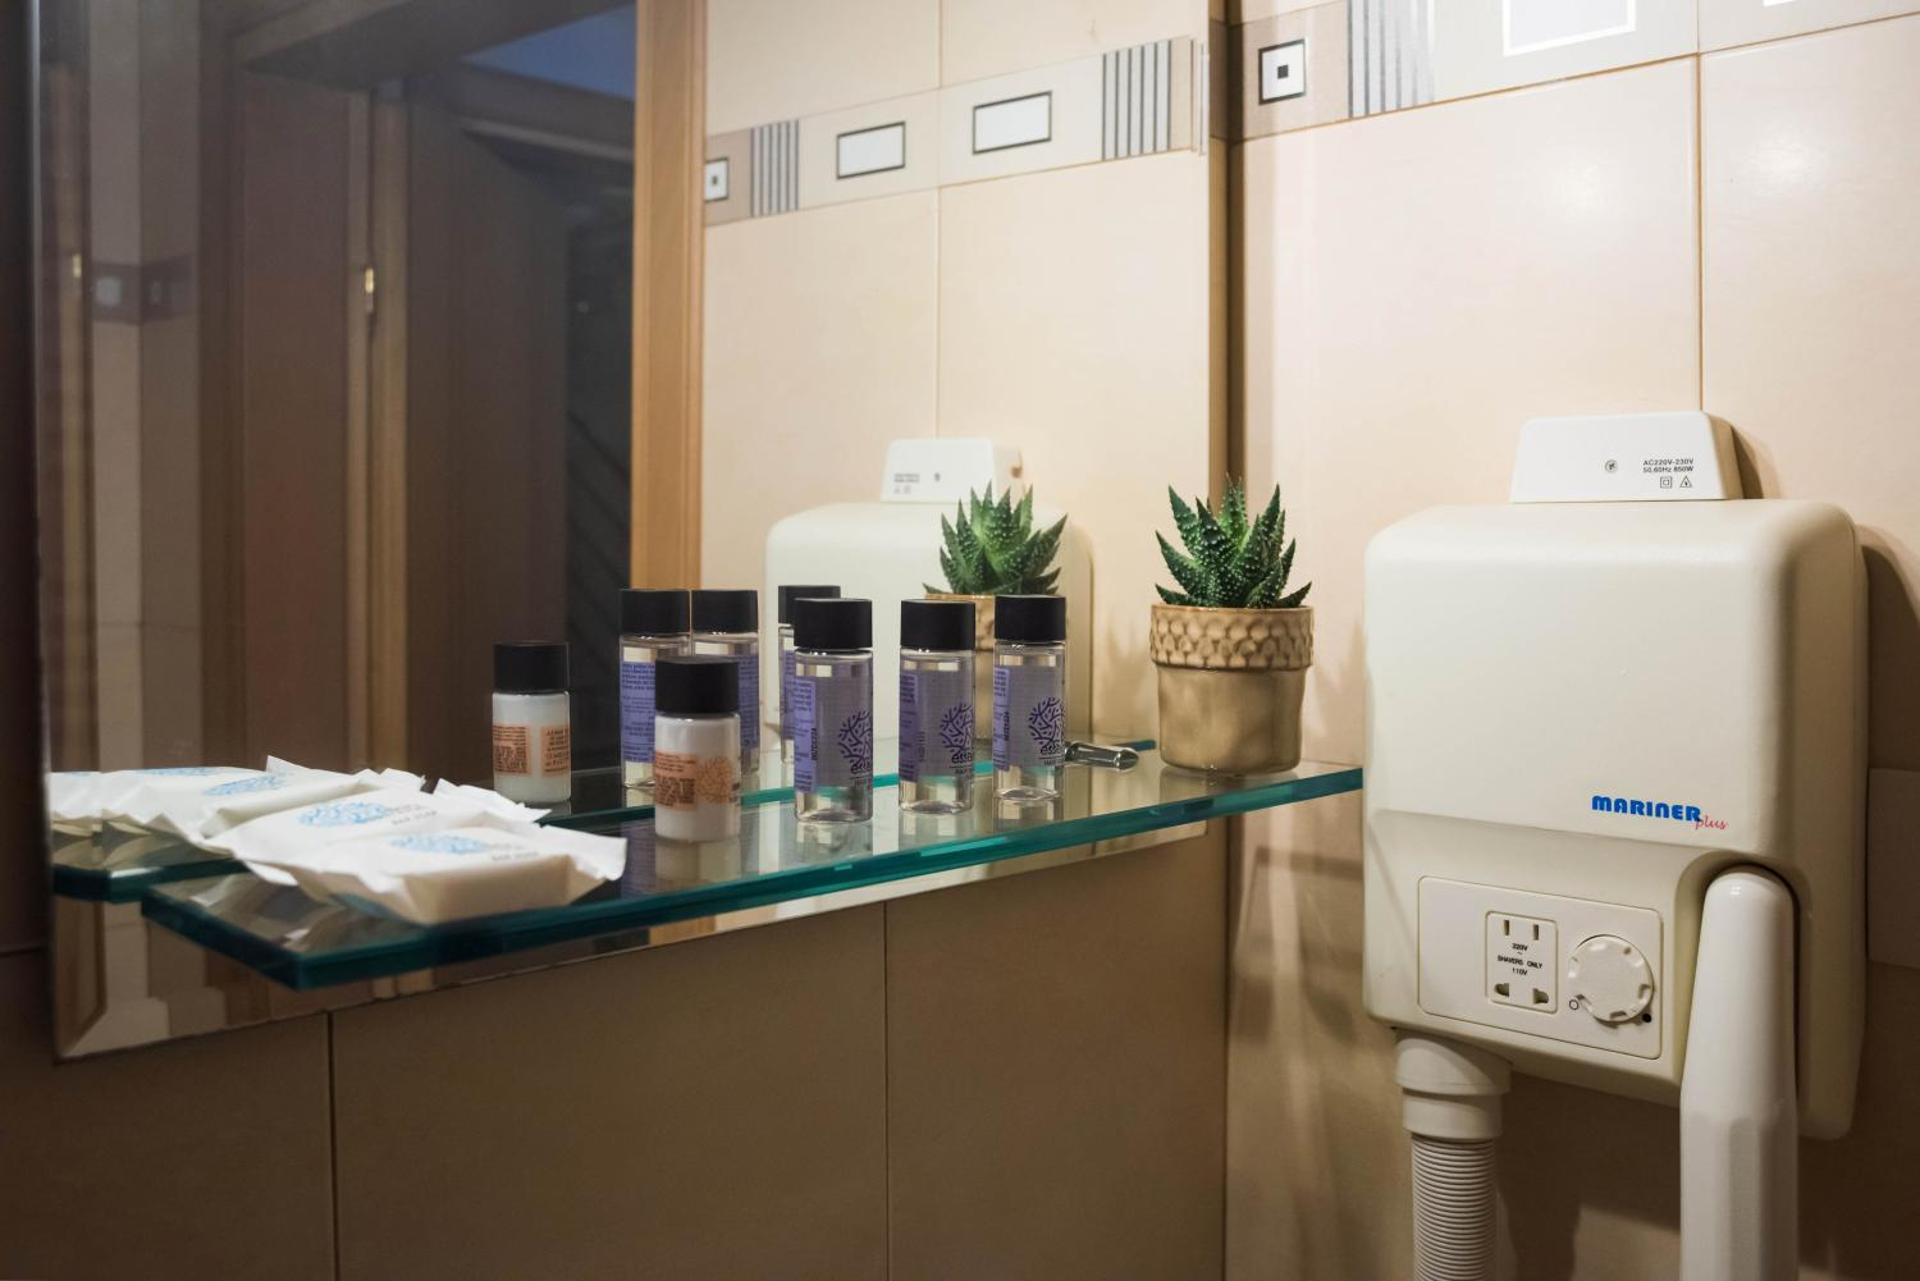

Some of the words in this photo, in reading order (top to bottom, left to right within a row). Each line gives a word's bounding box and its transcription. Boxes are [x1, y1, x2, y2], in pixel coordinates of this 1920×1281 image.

[1592, 796, 1701, 821] MARINER
[1695, 815, 1727, 830] plus
[1497, 954, 1523, 965] SHAVERS
[1527, 960, 1543, 969] ONLY
[1512, 967, 1528, 976] 110V
